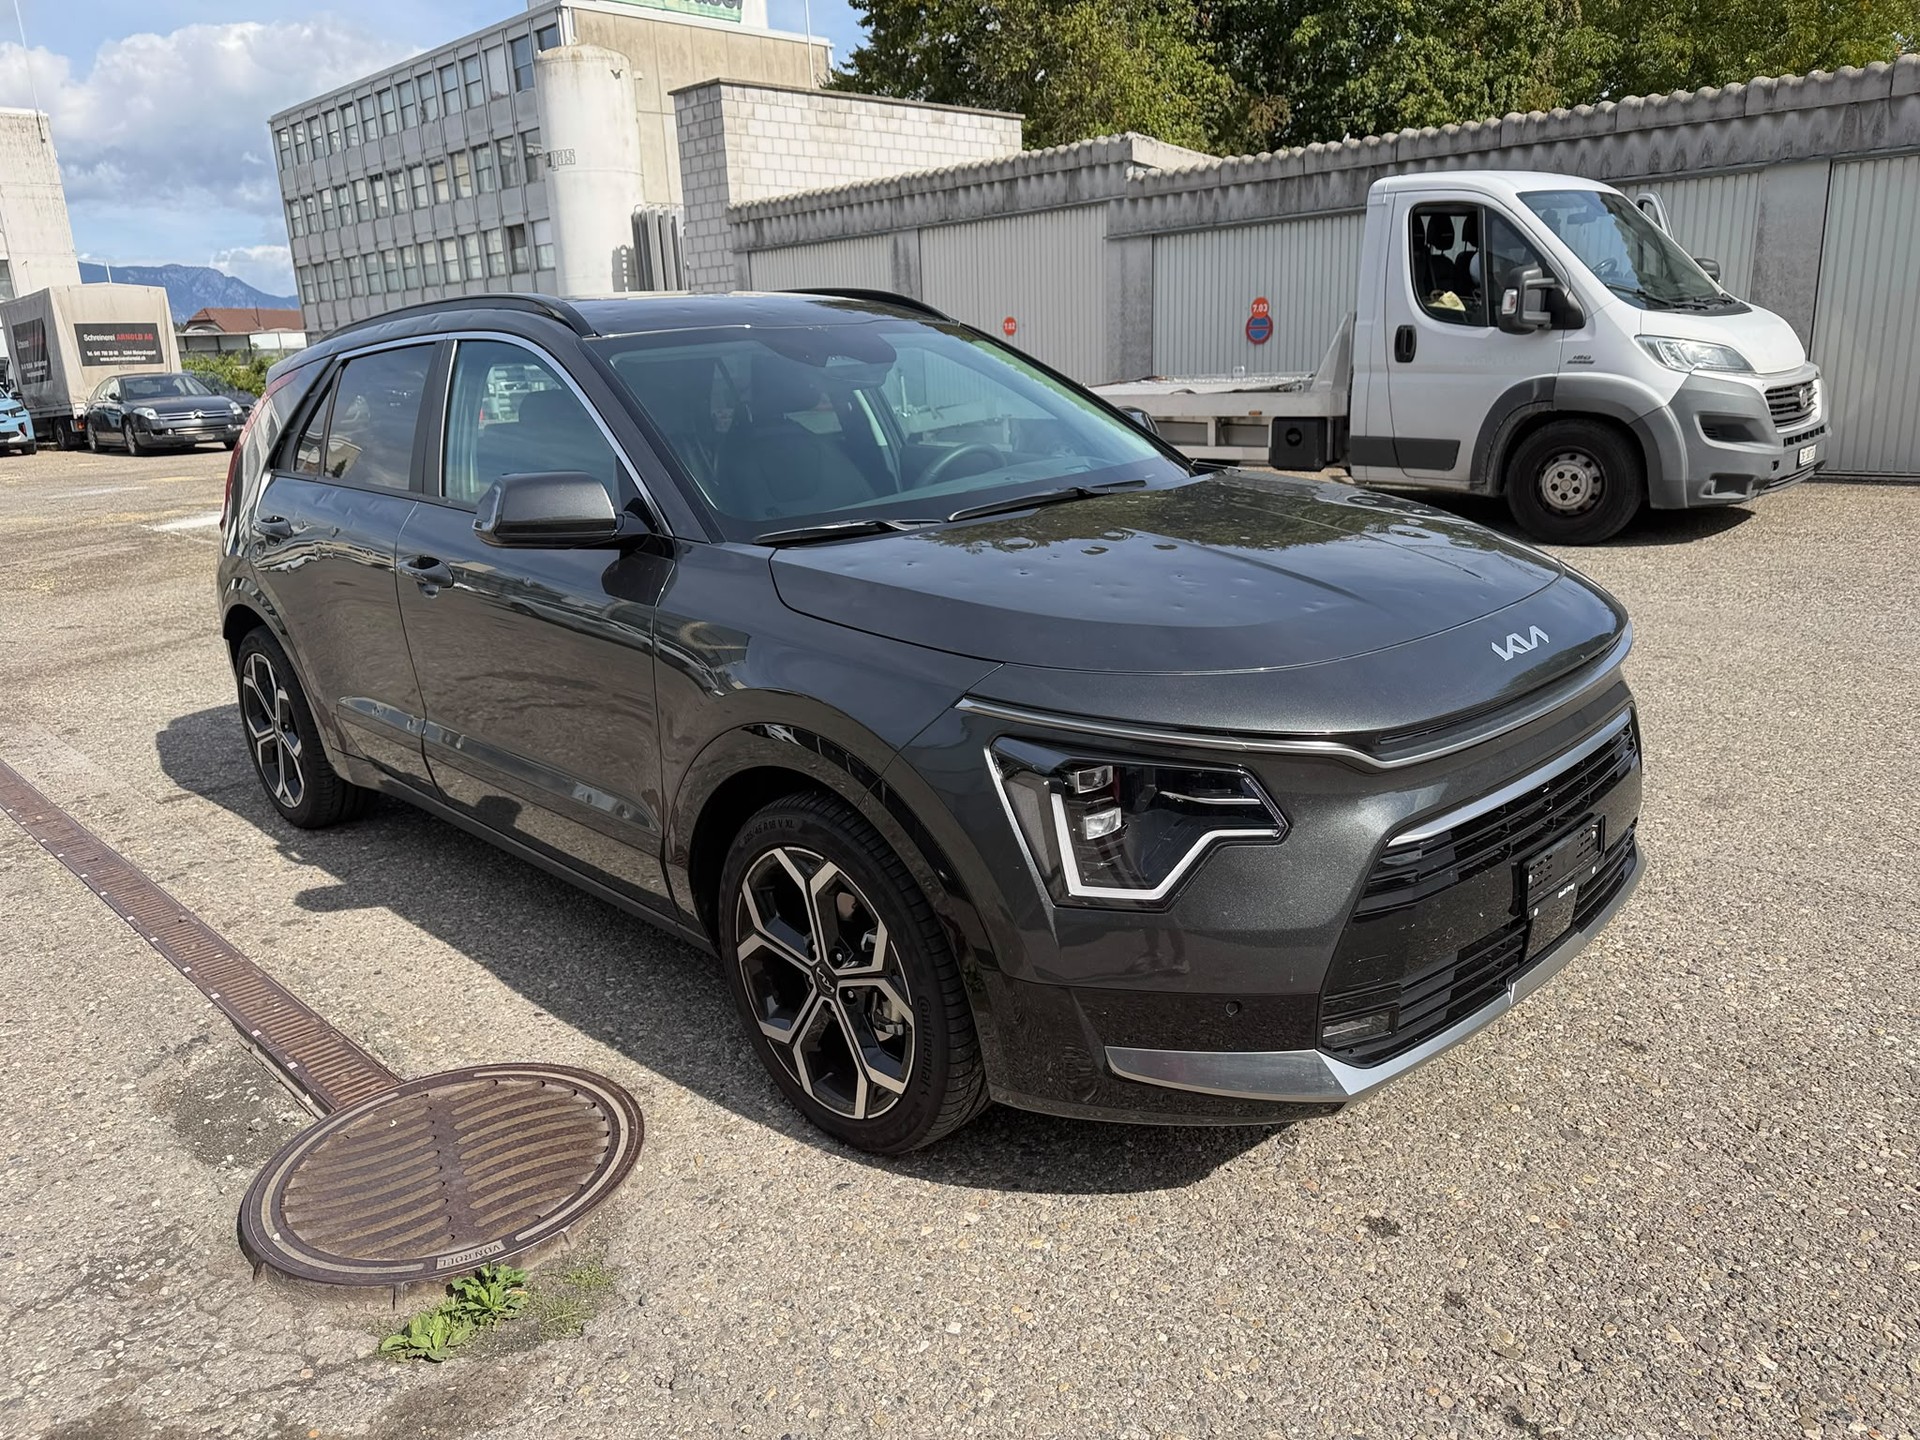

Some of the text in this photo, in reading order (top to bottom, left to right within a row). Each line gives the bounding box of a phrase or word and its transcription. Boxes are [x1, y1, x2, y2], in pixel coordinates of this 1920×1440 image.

[1252, 303, 1268, 313] 7.03
[83, 333, 153, 342] Schreinerei ARNOLD AG
[1491, 625, 1550, 662] KIA
[916, 995, 936, 1087] Continental
